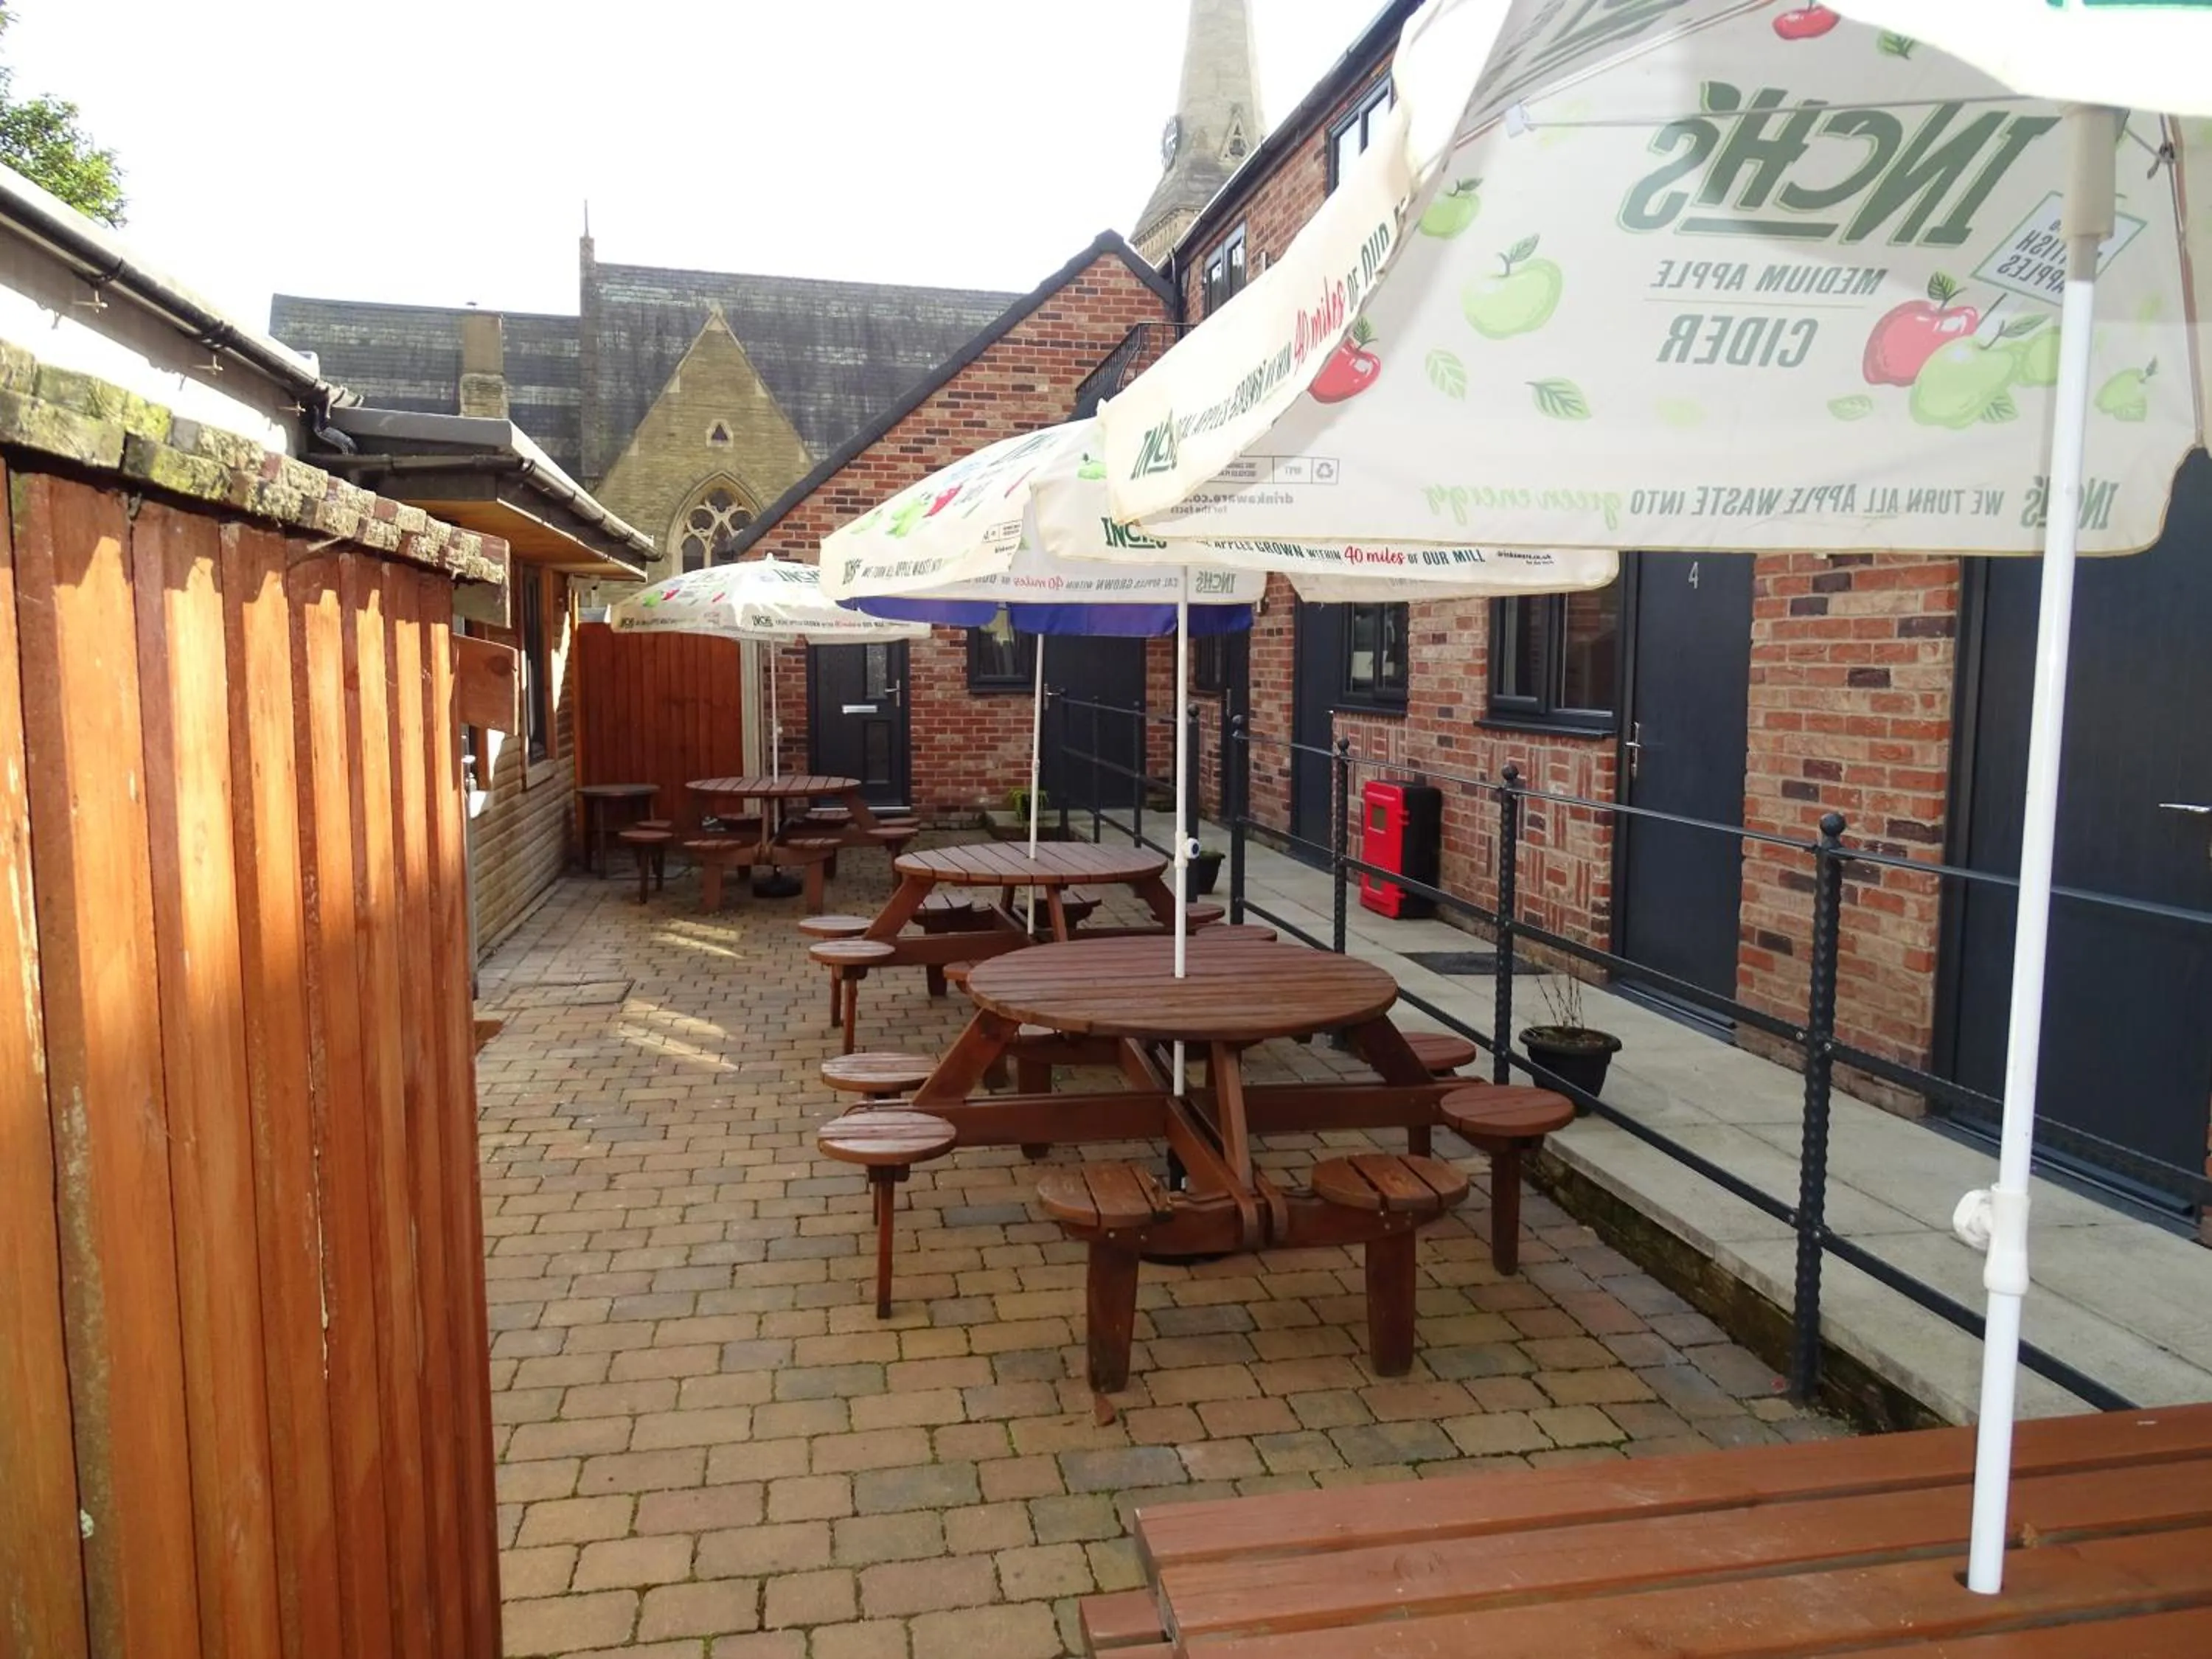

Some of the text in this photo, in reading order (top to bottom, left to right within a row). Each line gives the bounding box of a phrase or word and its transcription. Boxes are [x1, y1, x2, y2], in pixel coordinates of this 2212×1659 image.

[1311, 276, 1346, 352] miles
[1254, 541, 1305, 558] GROWN
[1306, 548, 1341, 560] WITHIN
[1344, 545, 1363, 565] 40
[1366, 546, 1405, 565] miles
[1408, 553, 1419, 564] OF
[1422, 550, 1450, 566] OUR
[1453, 549, 1486, 563] MILL
[1688, 561, 1699, 589] 4
